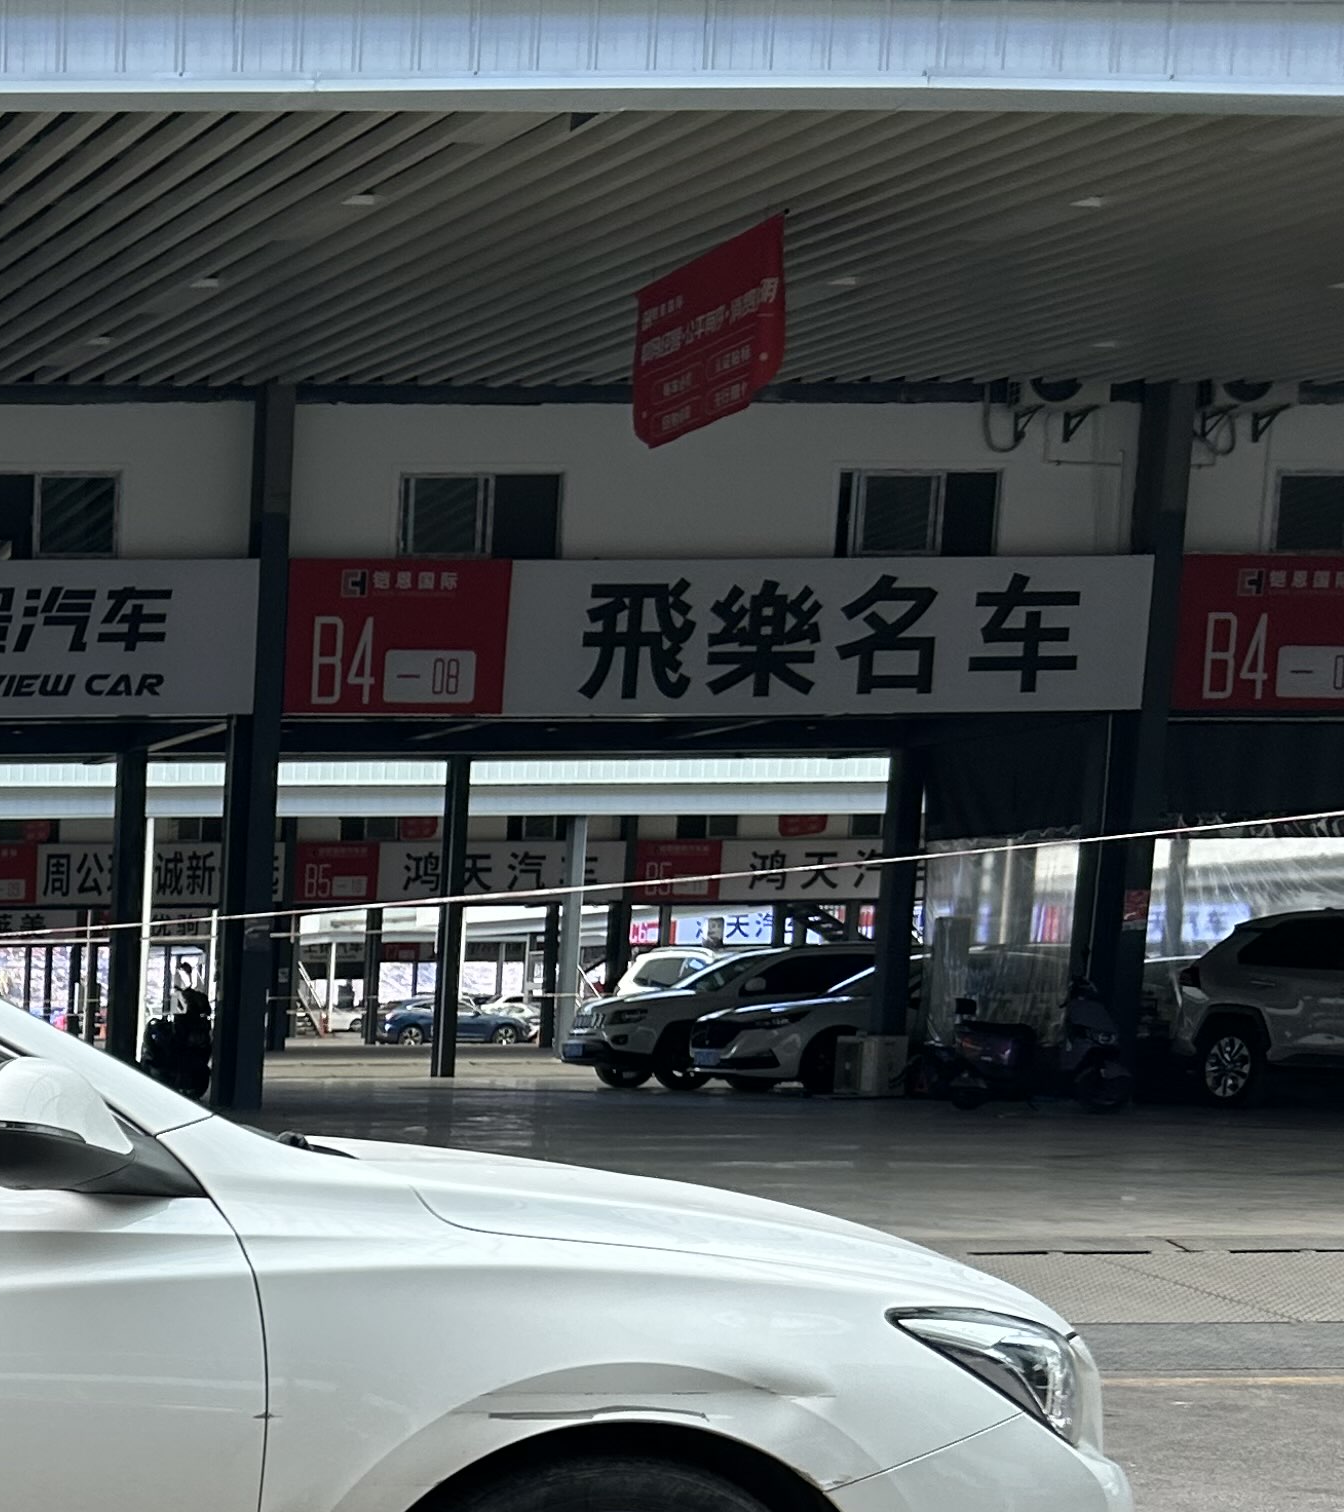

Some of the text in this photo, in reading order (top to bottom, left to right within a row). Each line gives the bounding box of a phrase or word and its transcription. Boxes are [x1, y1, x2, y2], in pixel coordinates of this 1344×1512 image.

[579, 573, 1081, 699] 飛樂名车
[84, 673, 165, 697] CAR
